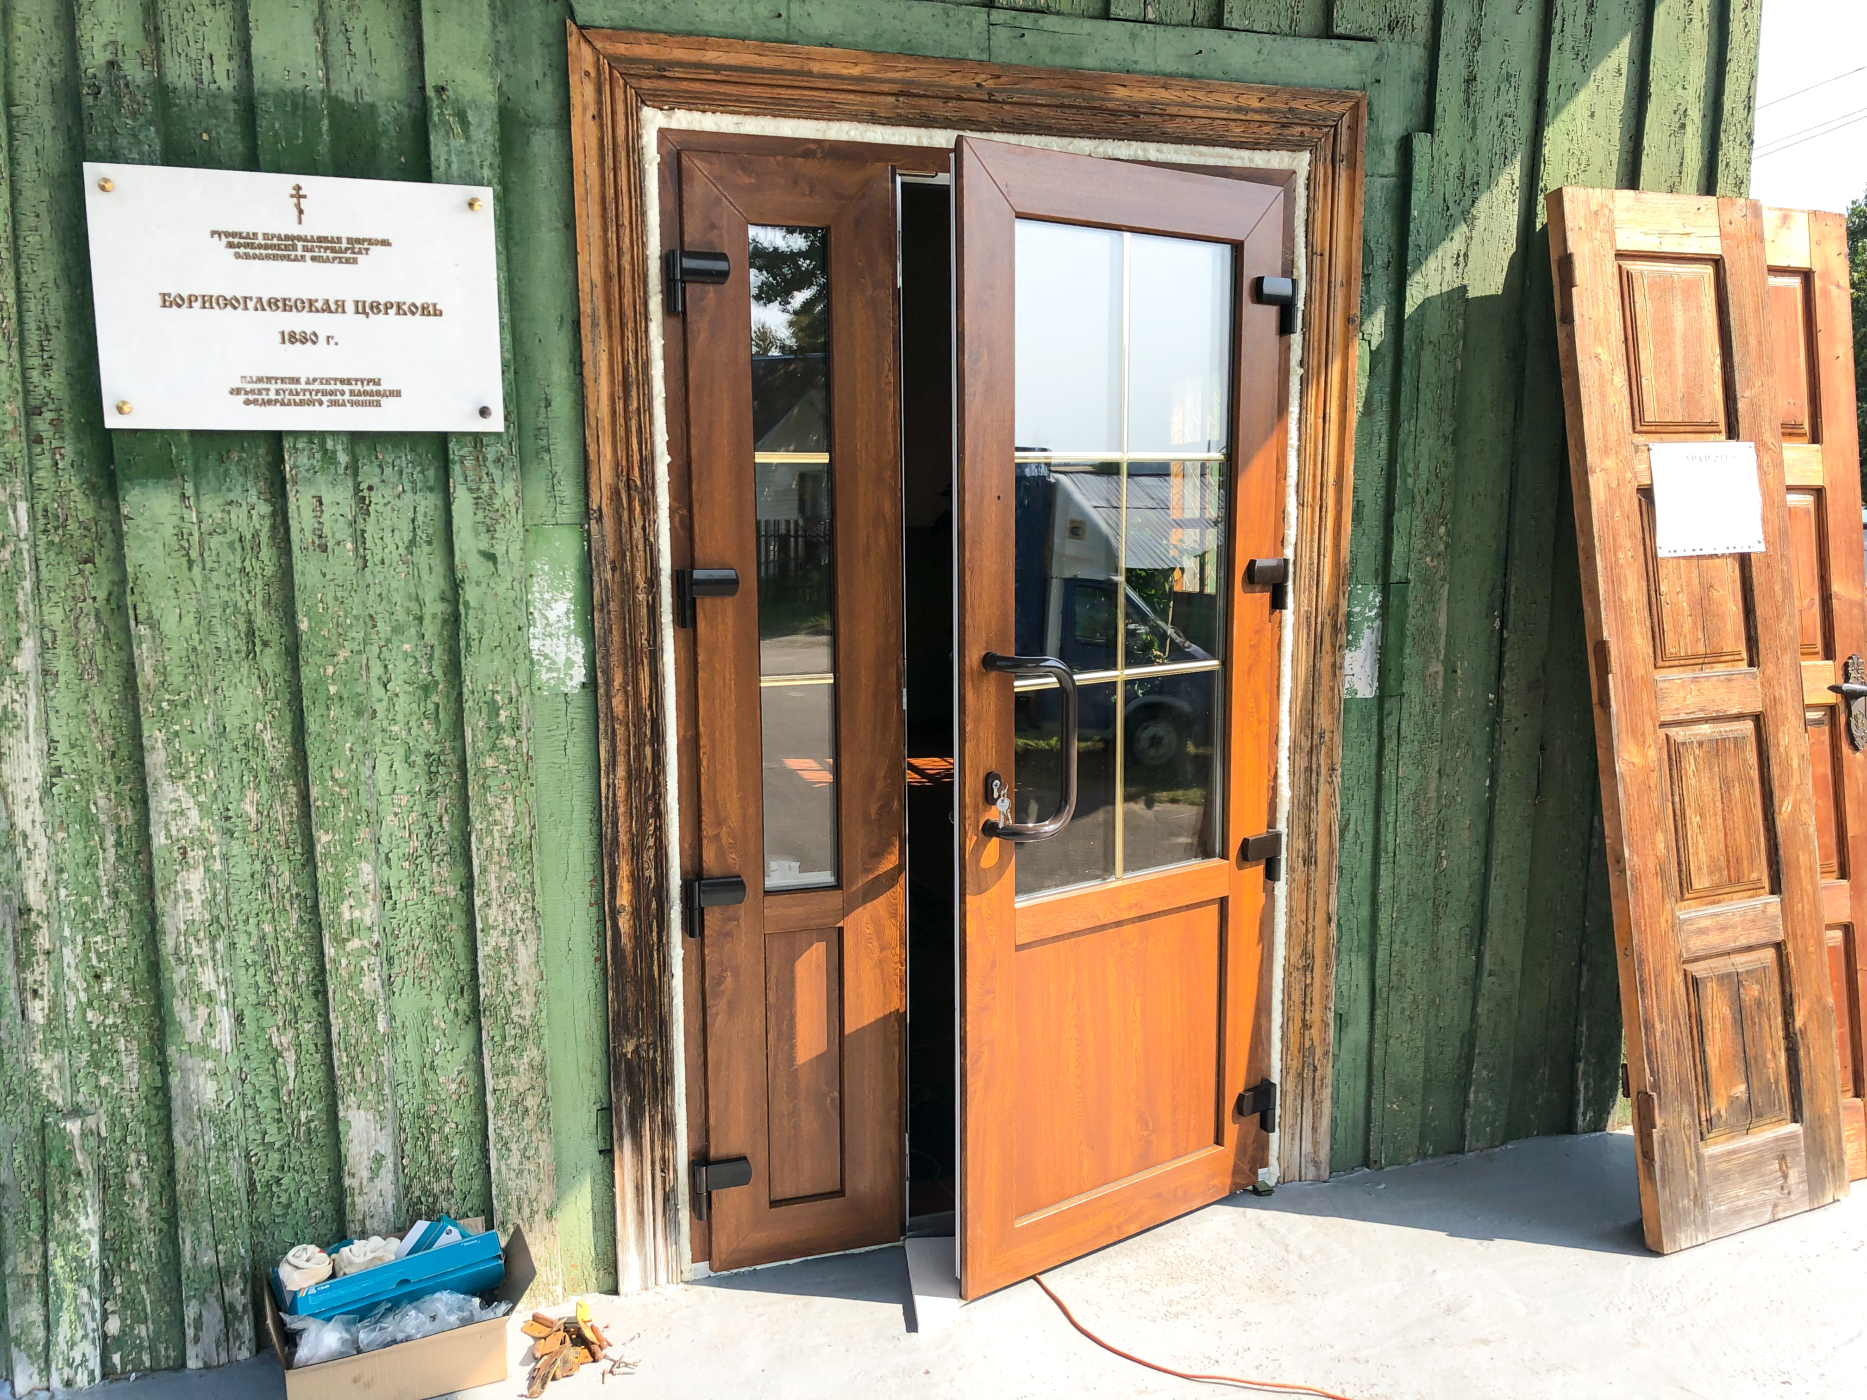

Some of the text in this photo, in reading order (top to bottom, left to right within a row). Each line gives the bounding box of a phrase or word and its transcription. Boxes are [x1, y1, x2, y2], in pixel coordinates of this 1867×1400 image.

[158, 292, 443, 319] БОРИСОГЛЕБСКАЯ ЦЕРКОВЬ
[278, 330, 339, 346] 1880 г.
